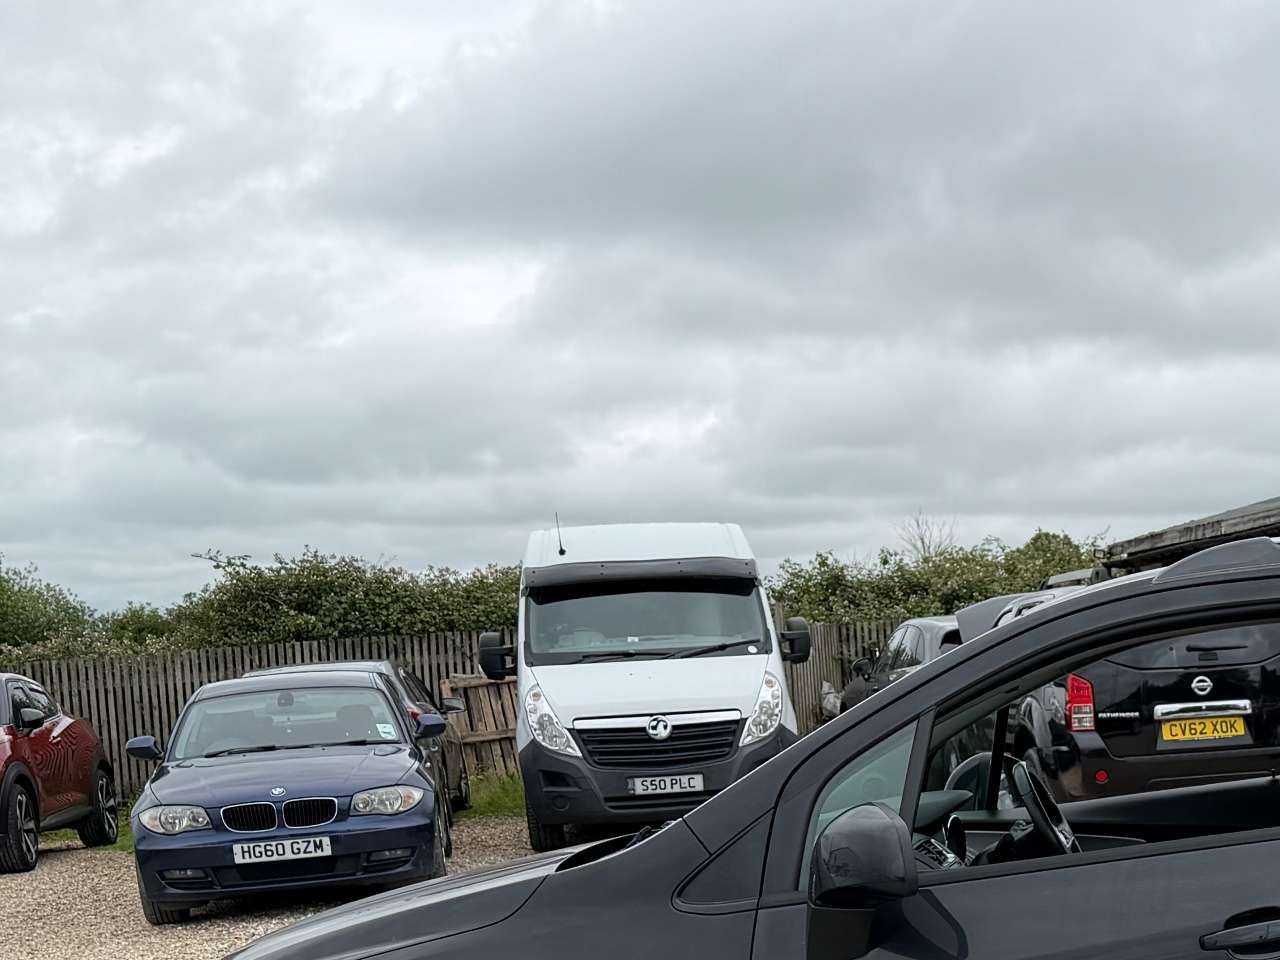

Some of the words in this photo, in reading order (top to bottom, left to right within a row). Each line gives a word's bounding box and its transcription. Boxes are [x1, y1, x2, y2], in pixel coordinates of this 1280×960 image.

[1098, 711, 1140, 719] PATHFINDER
[1169, 721, 1207, 737] CV62
[1210, 719, 1239, 734] XOK
[640, 779, 667, 791] S50
[670, 776, 697, 790] PLC
[240, 842, 286, 860] HG60
[290, 839, 325, 856] GZM
